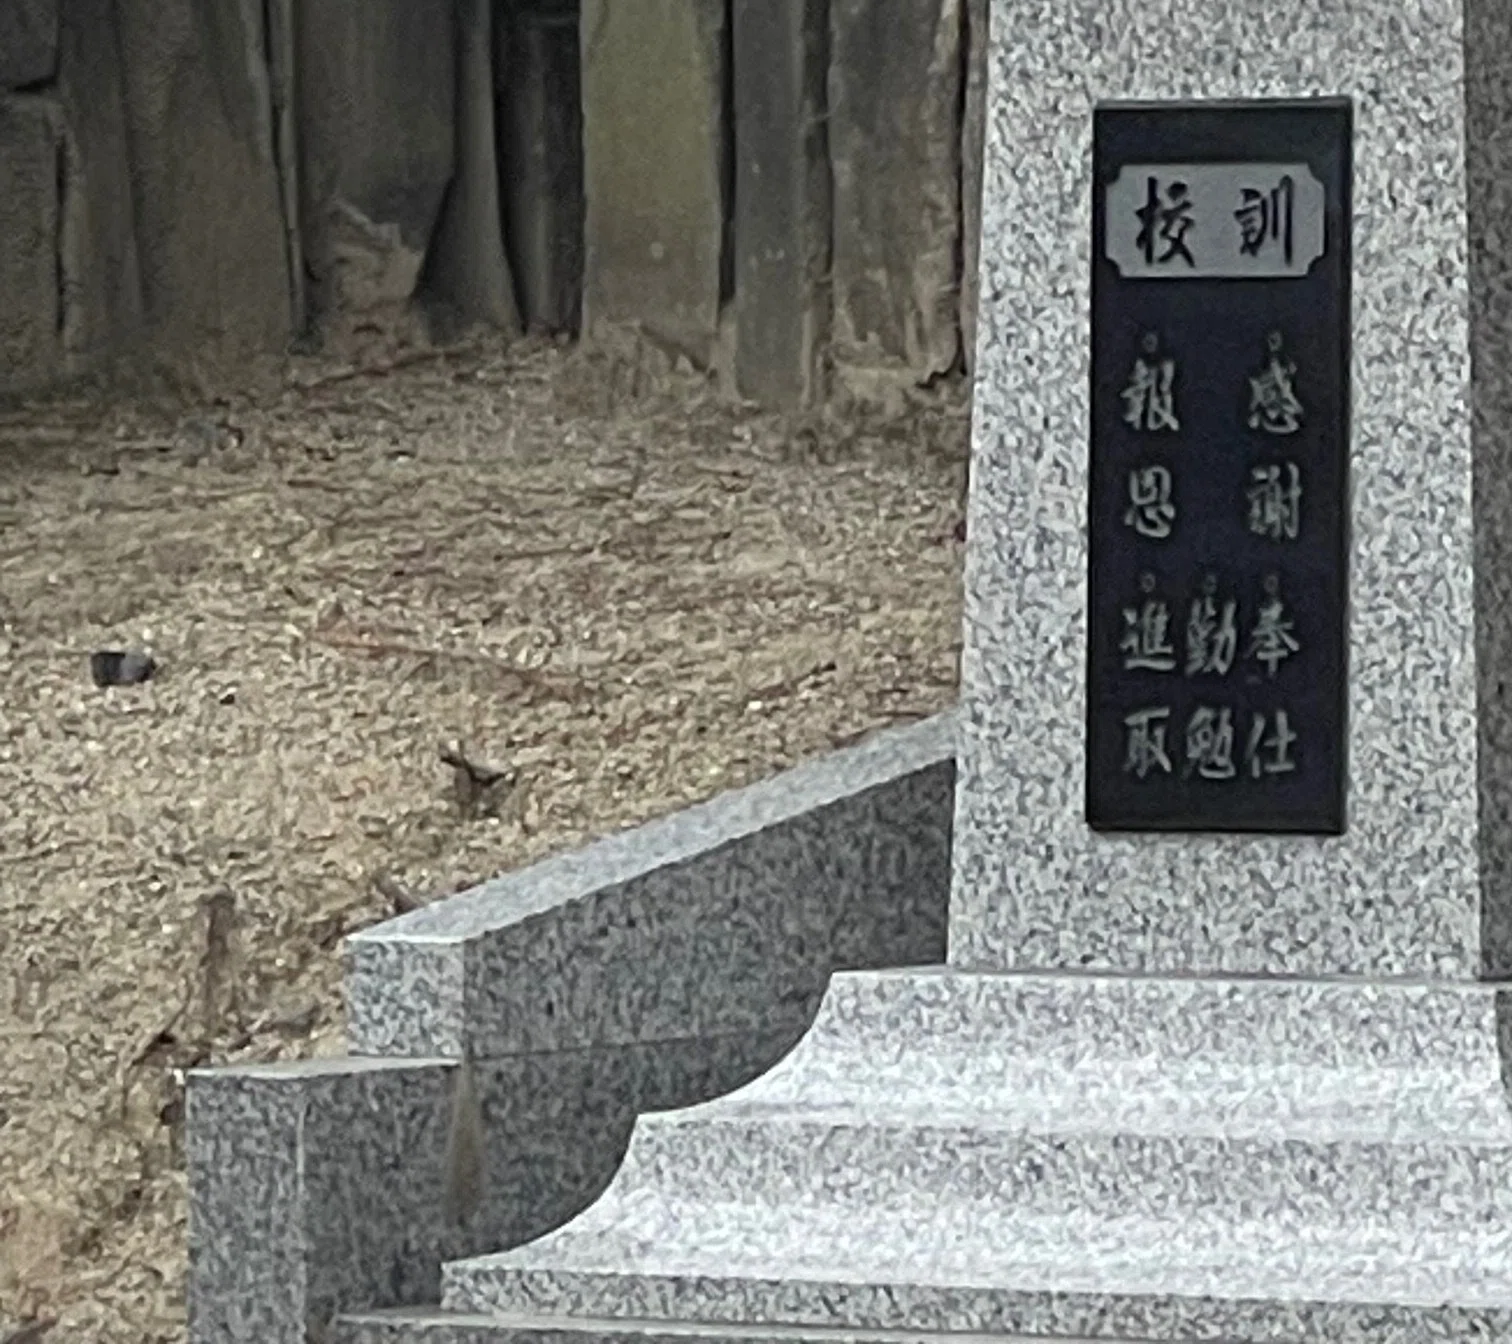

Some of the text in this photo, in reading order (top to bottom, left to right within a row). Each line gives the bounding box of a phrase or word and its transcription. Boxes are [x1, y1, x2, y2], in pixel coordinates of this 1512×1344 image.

[1135, 175, 1296, 268] 校訓
[1246, 355, 1304, 540] 感謝
[1246, 598, 1301, 780] 奉仕
